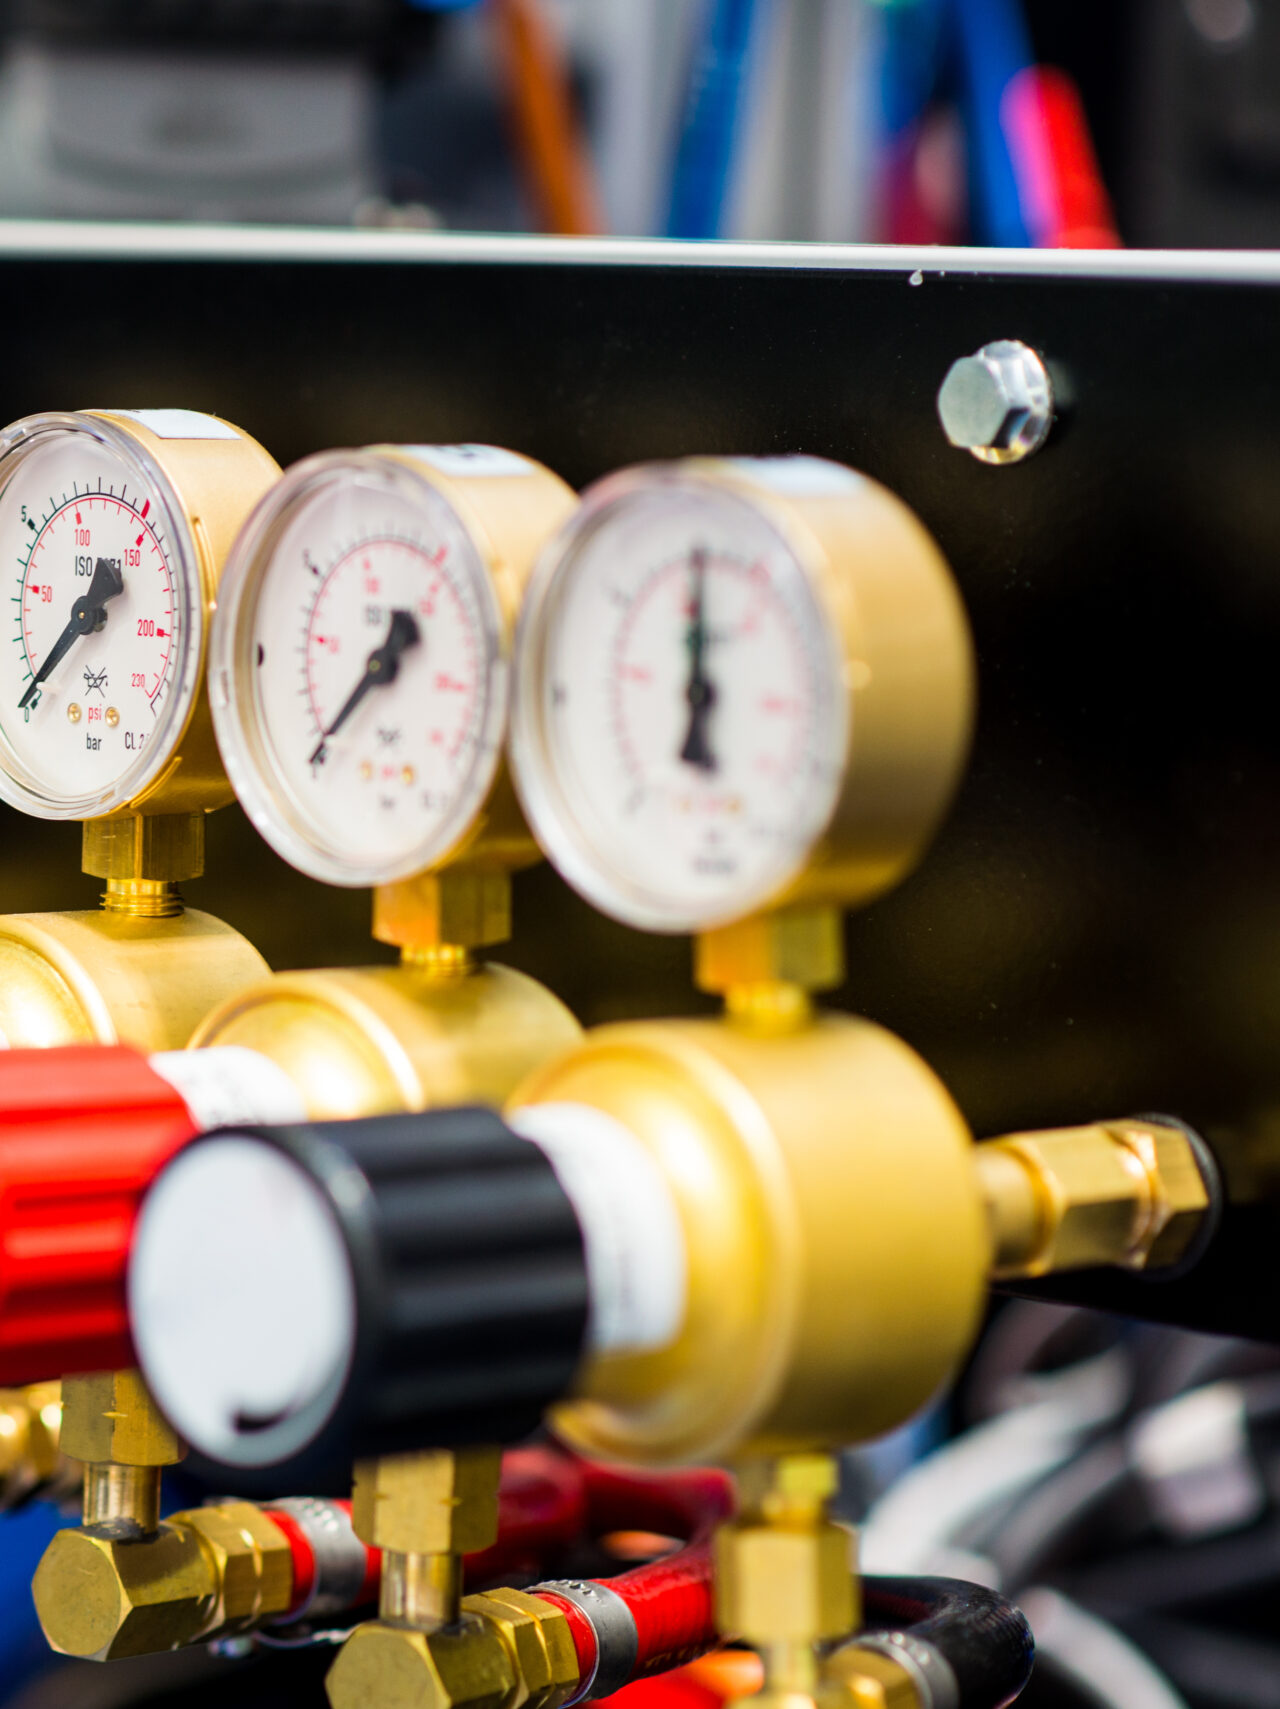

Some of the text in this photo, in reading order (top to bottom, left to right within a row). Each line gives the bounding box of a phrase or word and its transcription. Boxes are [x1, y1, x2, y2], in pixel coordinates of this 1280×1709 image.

[21, 505, 27, 522] 5
[74, 528, 91, 546] 100
[74, 555, 93, 576] ISO
[123, 548, 140, 566] 150
[41, 585, 52, 603] 50
[137, 619, 154, 637] 200
[131, 673, 145, 688] 230
[88, 704, 102, 724] psi
[86, 732, 102, 751] bar
